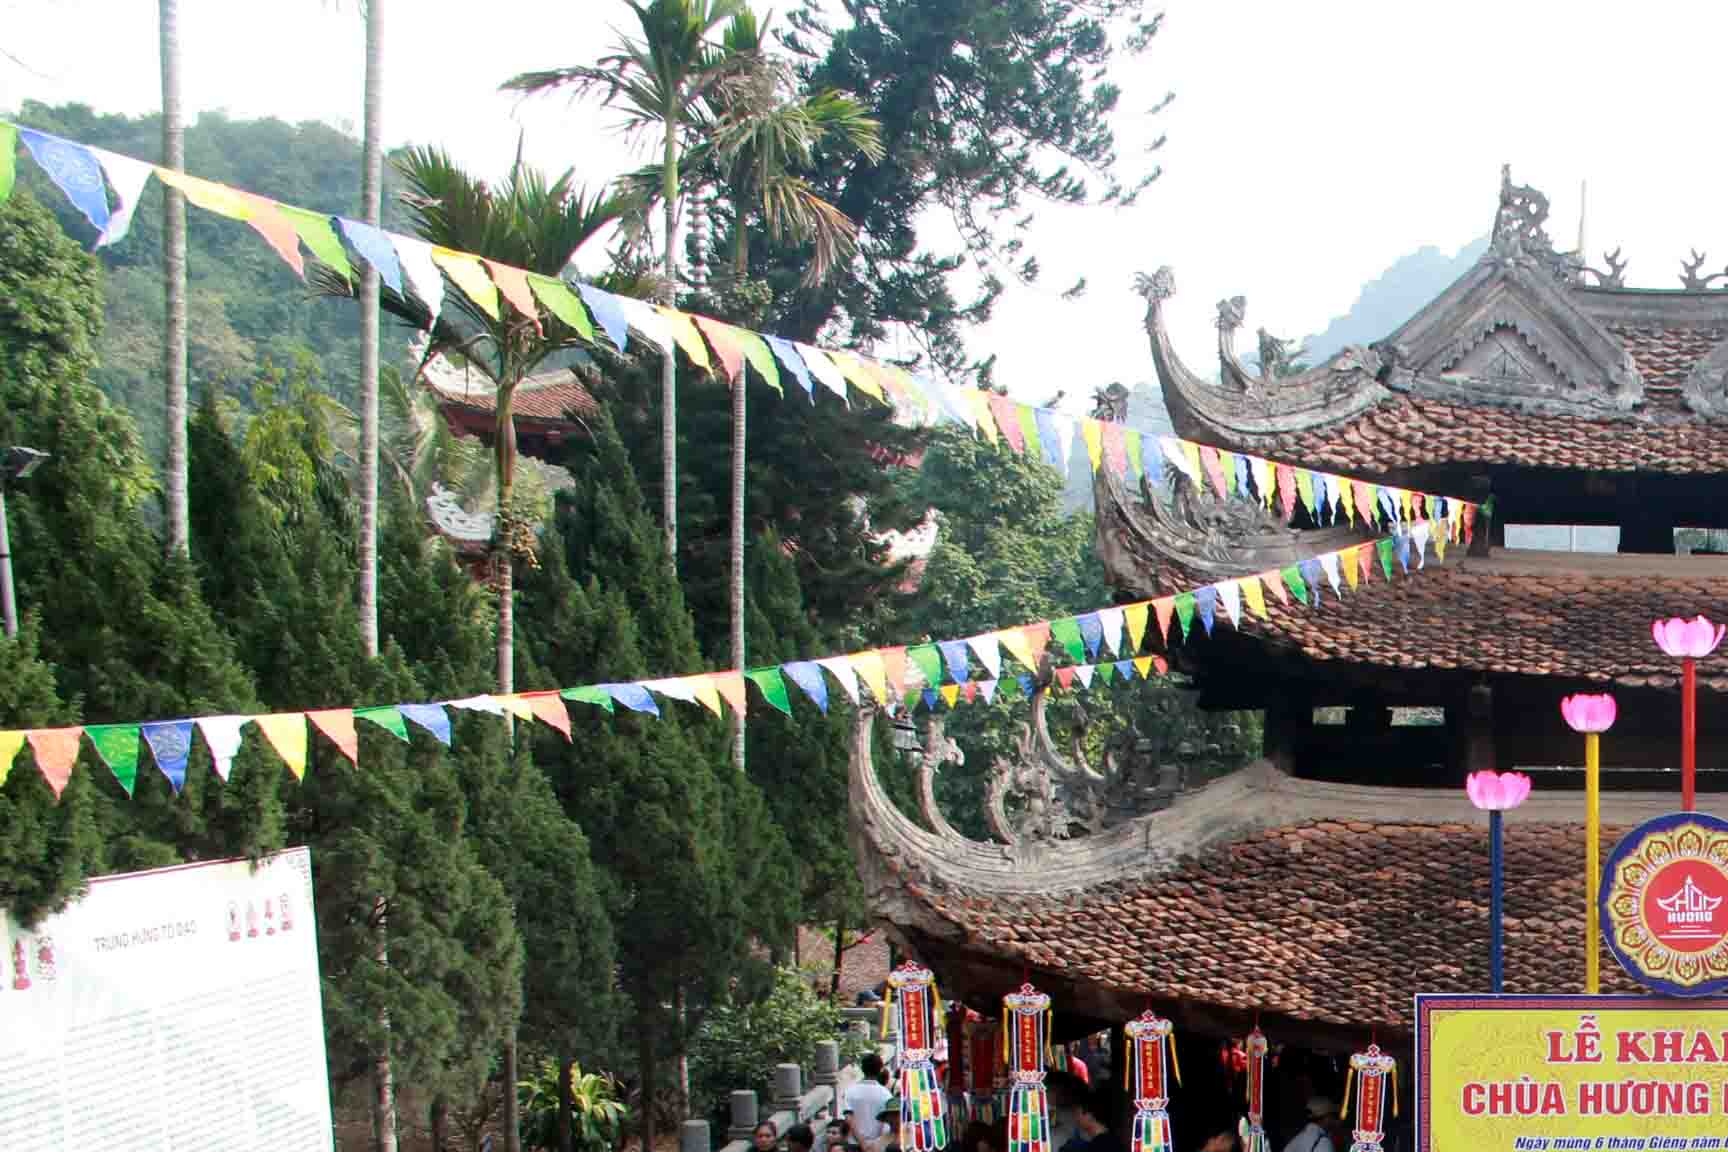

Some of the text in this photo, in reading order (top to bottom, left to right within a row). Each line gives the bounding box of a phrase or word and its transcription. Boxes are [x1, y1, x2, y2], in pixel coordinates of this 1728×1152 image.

[1546, 1015, 1602, 1063] LỄ
[1462, 1076, 1566, 1115] CHÙA
[1579, 1080, 1710, 1115] HƯƠNG
[1514, 1136, 1550, 1150] Ngày
[1595, 1136, 1604, 1149] 6
